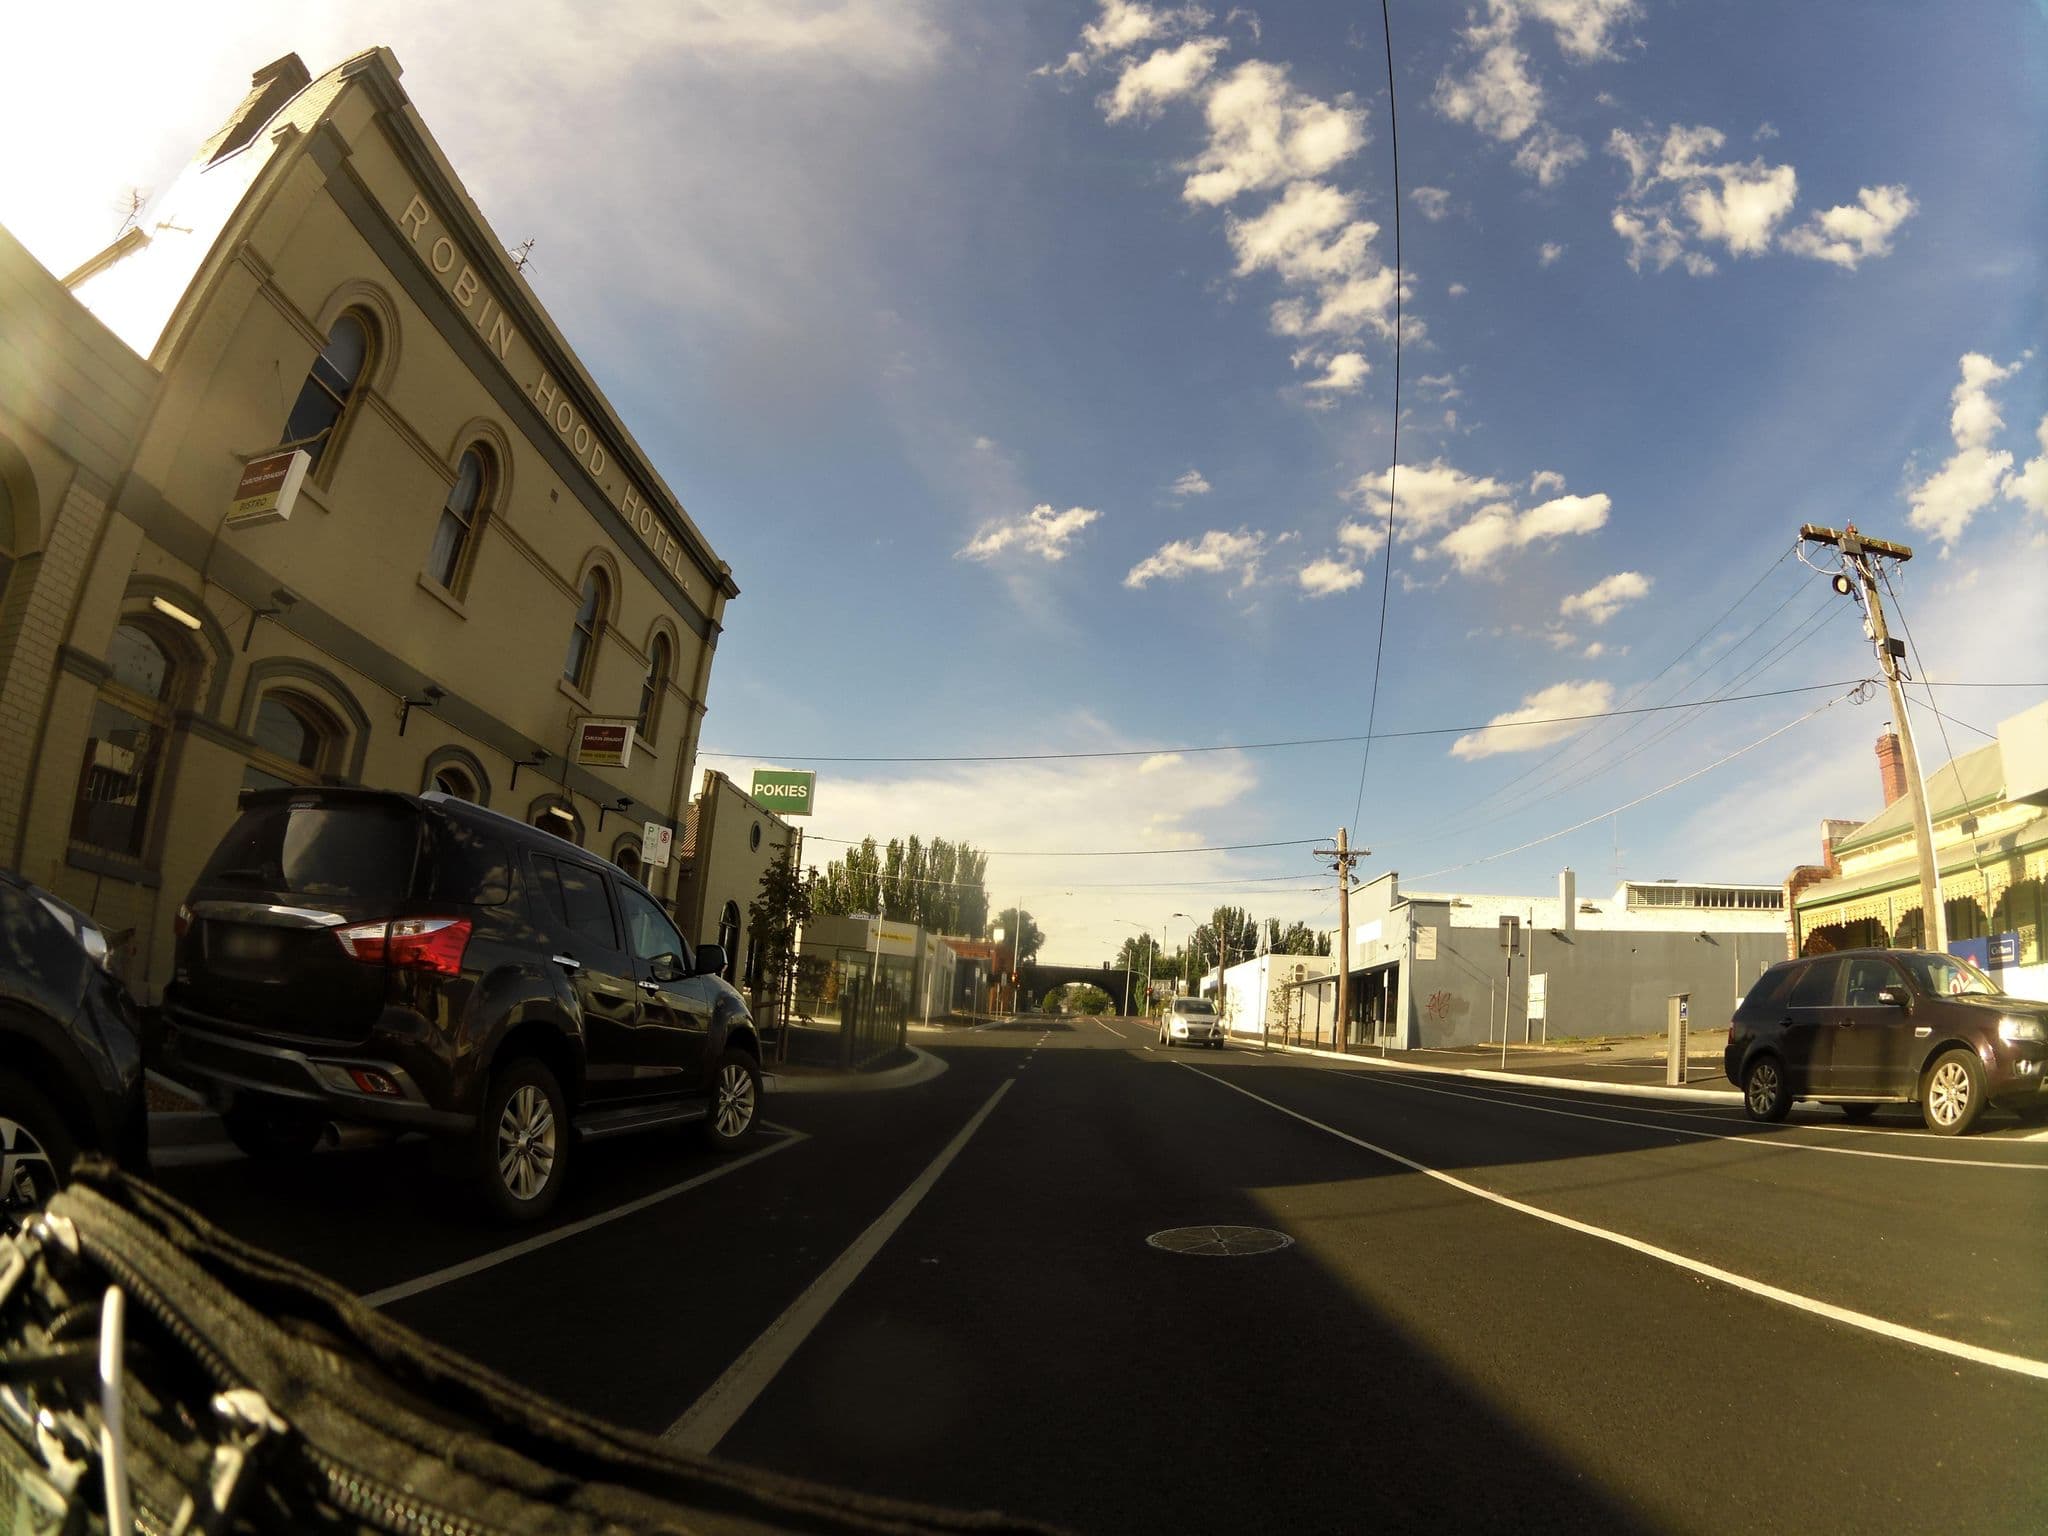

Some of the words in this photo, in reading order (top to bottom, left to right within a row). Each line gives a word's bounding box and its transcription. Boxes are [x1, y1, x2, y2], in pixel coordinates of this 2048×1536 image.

[398, 193, 514, 361] ROBIN
[533, 372, 606, 477] HOOD
[754, 783, 808, 798] POKIES
[1680, 1002, 1687, 1011] P
